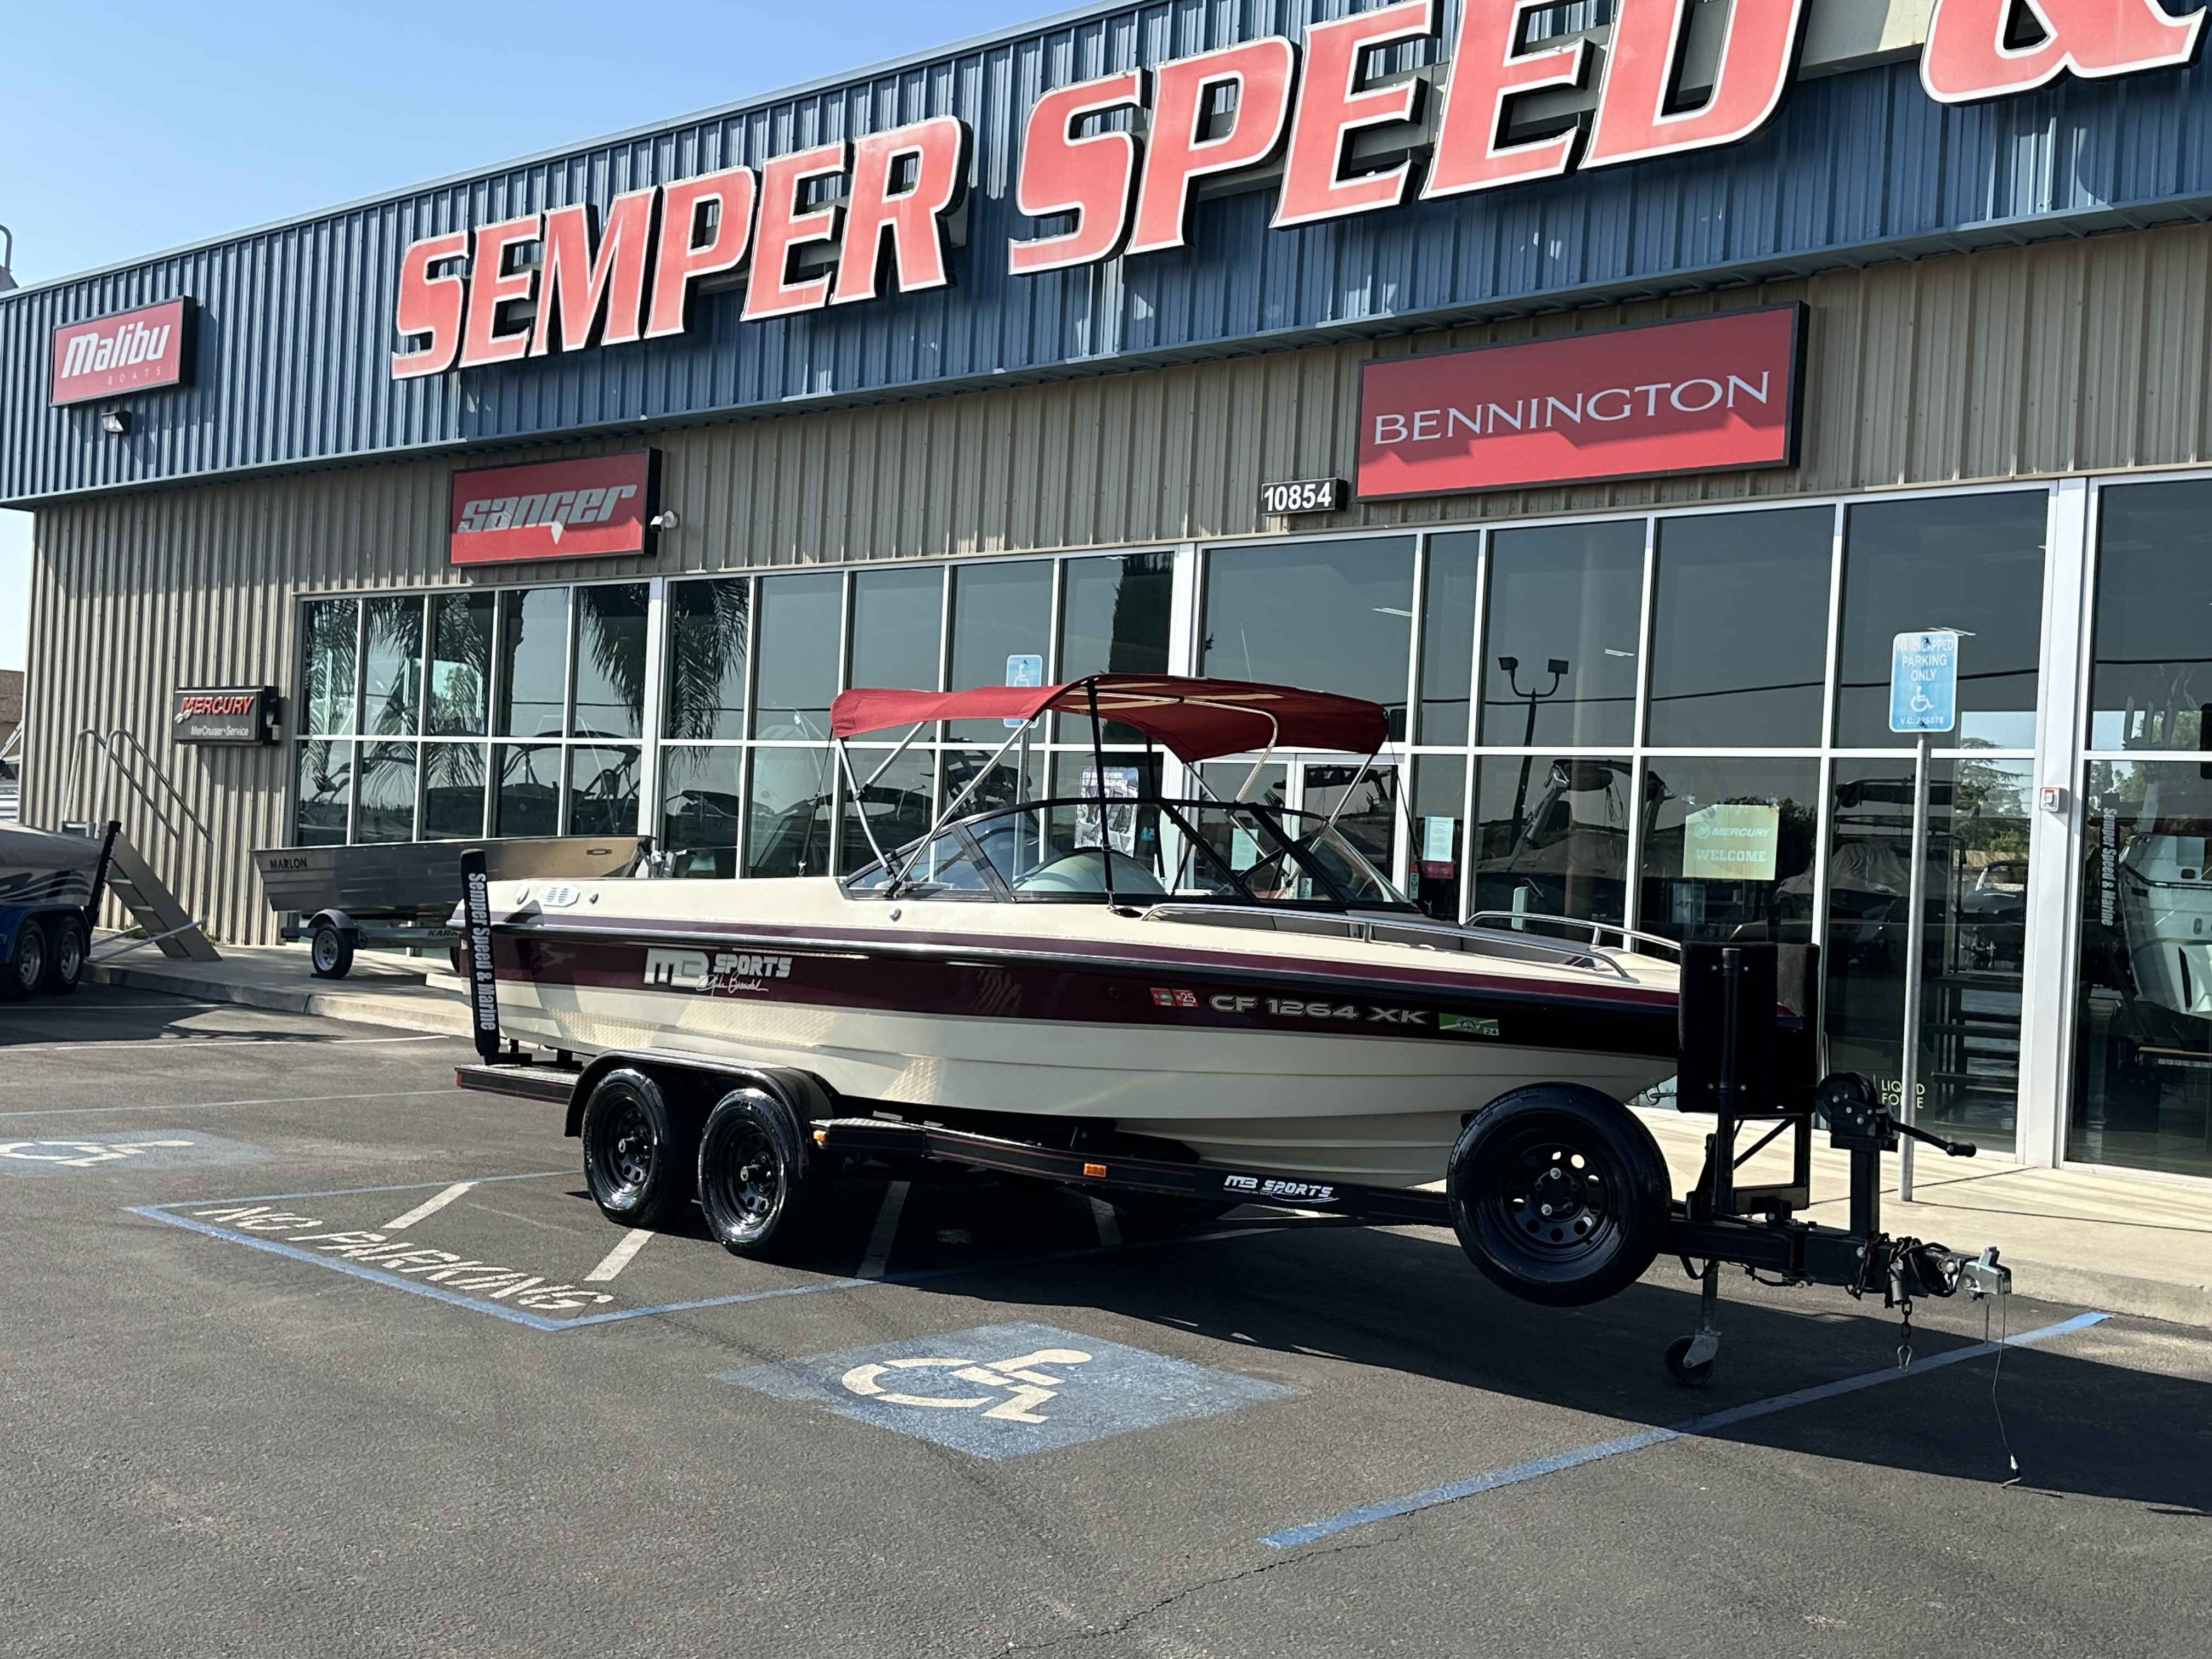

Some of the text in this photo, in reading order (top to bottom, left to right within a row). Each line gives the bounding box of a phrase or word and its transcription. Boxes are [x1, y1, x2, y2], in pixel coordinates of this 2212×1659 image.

[392, 0, 1804, 380] SEMPER SPEED
[61, 321, 171, 379] Malibu
[108, 366, 161, 385] BOATS
[1374, 370, 1769, 444] BENNINGTON
[1263, 482, 1331, 511] 10854
[1902, 654, 1947, 667] PARKING
[1911, 669, 1937, 681] ONLY
[181, 696, 255, 714] MERCURY
[1712, 827, 1770, 837] MERCURY
[2103, 807, 2117, 847] Semper
[270, 857, 307, 869] MARLON
[1695, 849, 1767, 862] WELCOME
[2102, 848, 2117, 881] Speed
[2101, 890, 2116, 926] Marine
[469, 873, 496, 1030] Semper Speed & Marine
[643, 948, 709, 988] MB
[714, 953, 792, 978] SPORTS
[1210, 995, 1429, 1024] CF 1264 XK
[1882, 1080, 1925, 1094] LIQD
[1882, 1093, 1923, 1109] FOE
[1224, 1175, 1258, 1189] MB
[1262, 1180, 1334, 1198] SPORTS
[192, 1206, 614, 1309] NO PARKING
